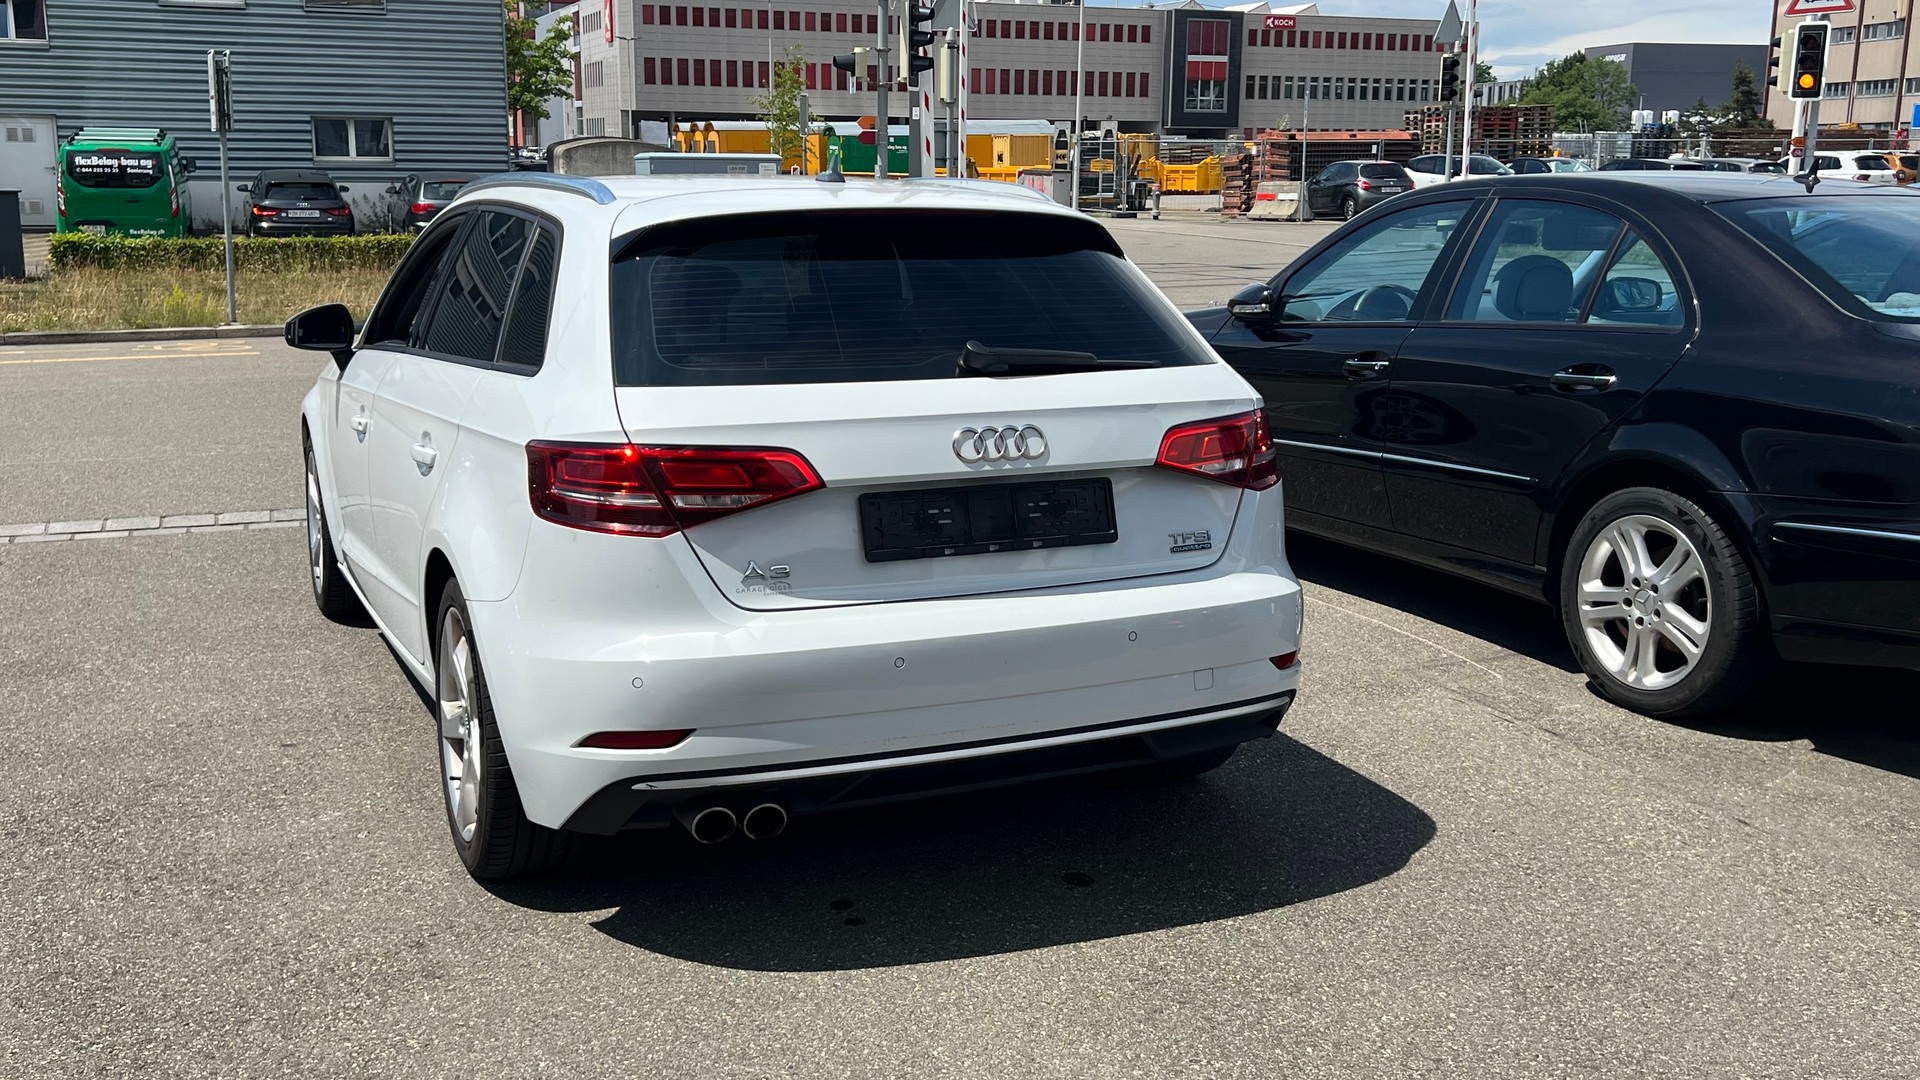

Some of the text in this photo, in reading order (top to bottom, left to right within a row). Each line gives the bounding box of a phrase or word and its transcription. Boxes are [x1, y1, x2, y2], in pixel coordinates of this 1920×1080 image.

[75, 156, 152, 168] flexBelag bau ag
[1172, 543, 1211, 552] quattro
[742, 560, 790, 581] A3
[735, 586, 767, 594] GARAGE
